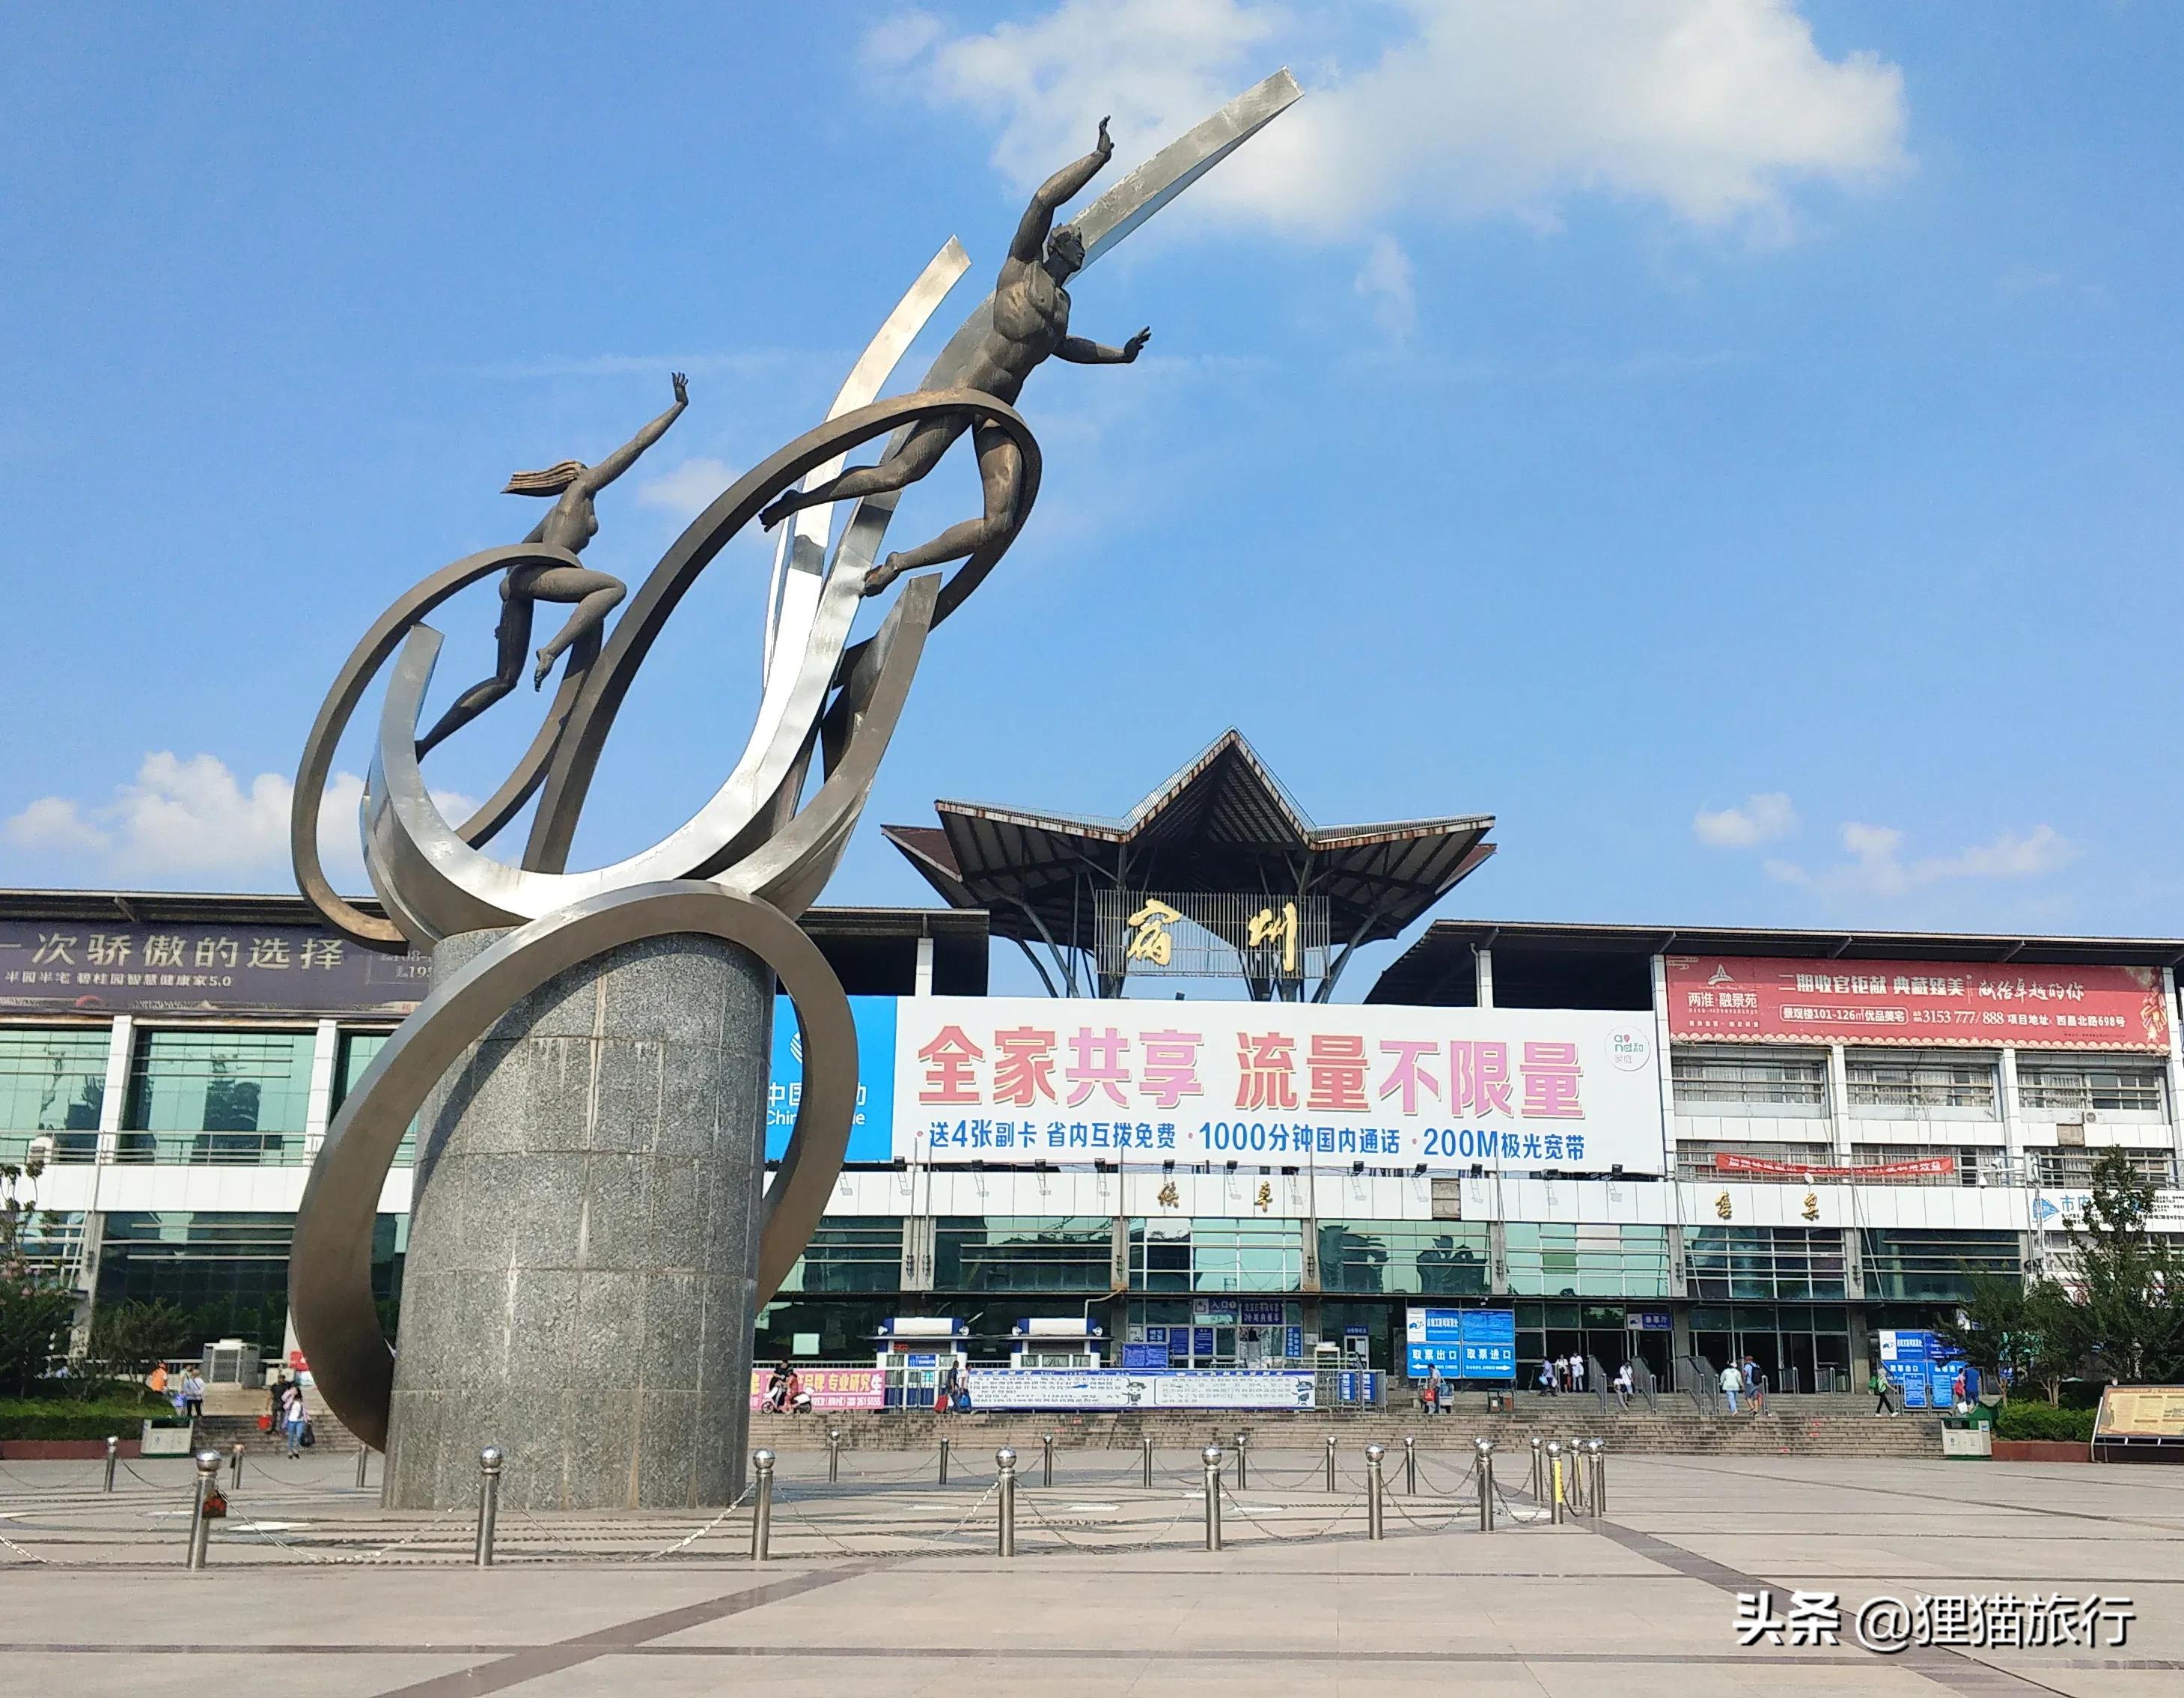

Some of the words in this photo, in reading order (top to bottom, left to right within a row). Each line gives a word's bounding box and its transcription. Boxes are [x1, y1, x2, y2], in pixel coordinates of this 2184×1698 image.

[1893, 976, 1965, 997] 典藏臻美
[918, 1026, 1204, 1110] 全家共享
[1235, 1032, 1585, 1119] 流量不限量
[930, 1119, 1038, 1149] 送4张副卡
[1046, 1122, 1176, 1151] 省内互拨免费
[1199, 1122, 1400, 1154] 1000分钟国内通话
[1424, 1128, 1585, 1162] 200M极光宽带
[1412, 1348, 1458, 1360] 取票出口
[1466, 1348, 1512, 1360] 取票进口
